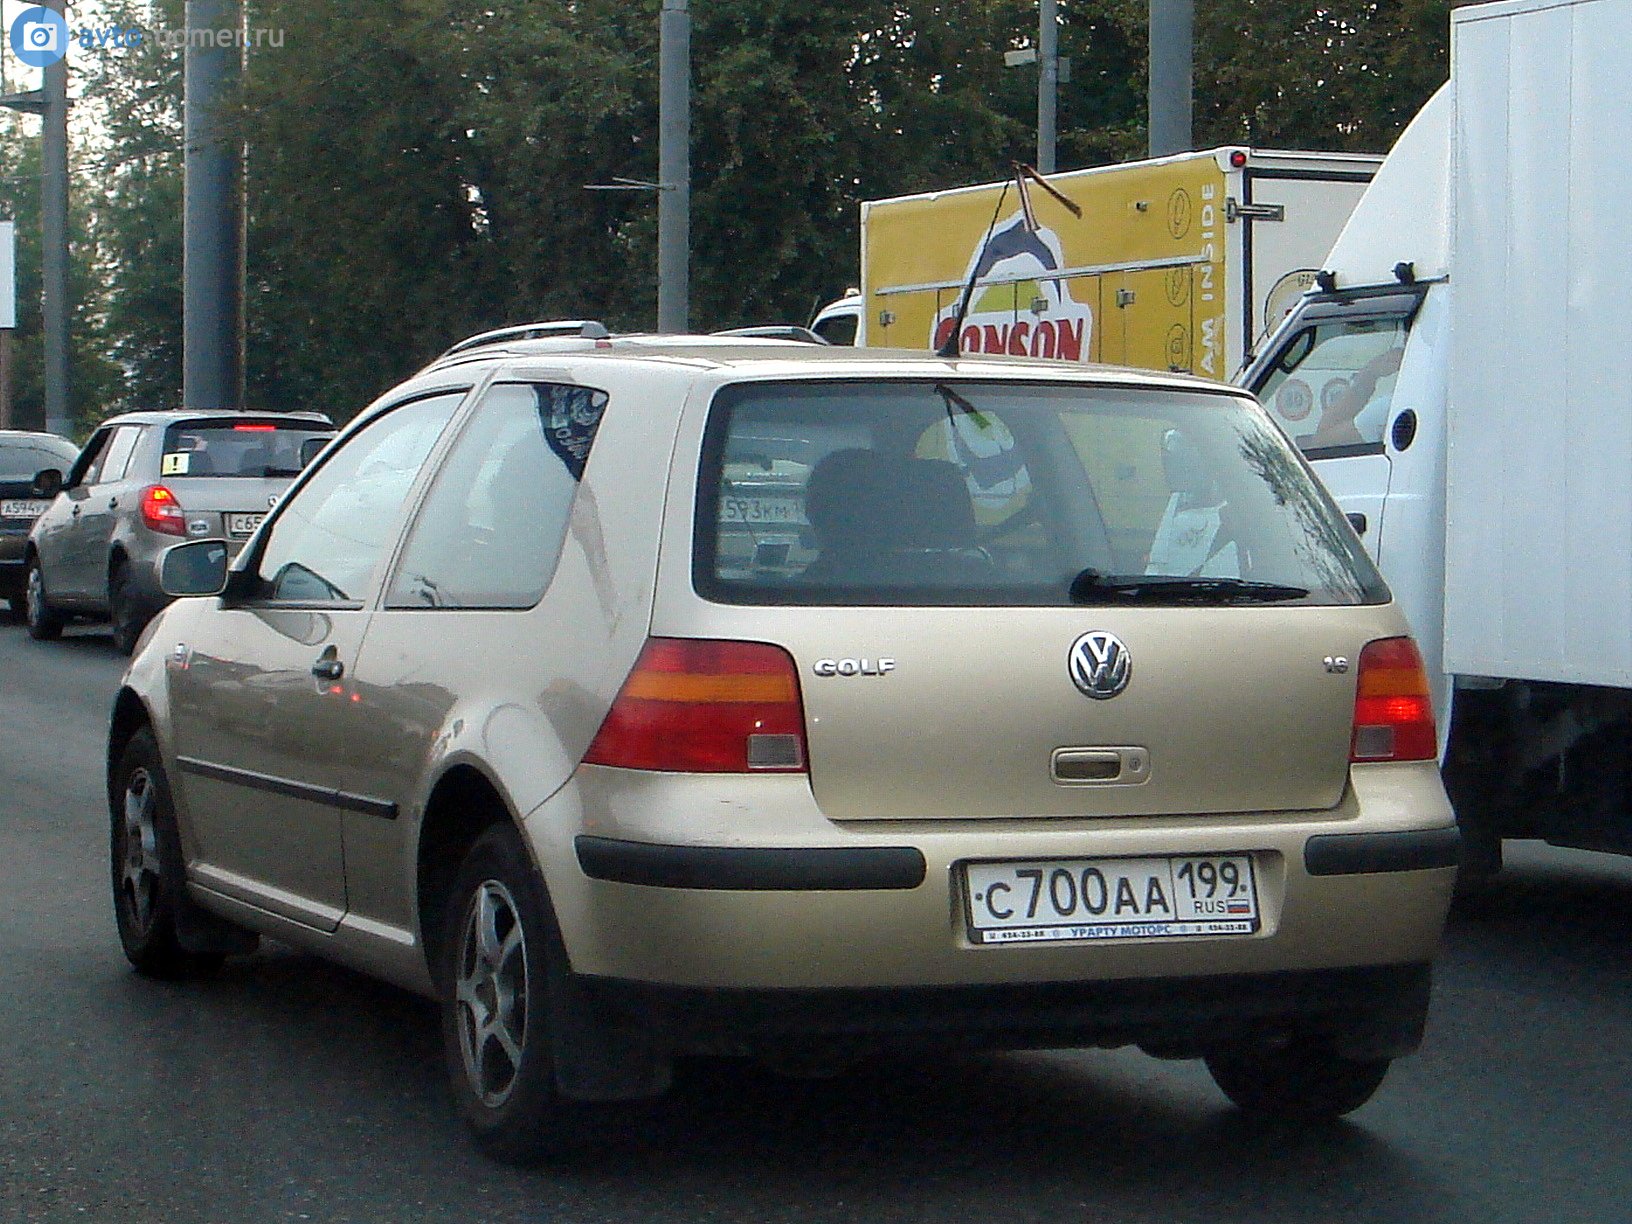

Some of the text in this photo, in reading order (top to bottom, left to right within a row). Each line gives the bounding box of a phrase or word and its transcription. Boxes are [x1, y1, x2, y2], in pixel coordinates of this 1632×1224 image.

[813, 657, 895, 677] GOLF
[1177, 861, 1240, 899] 199
[1194, 899, 1226, 914] RUS
[1071, 926, 1118, 938] УРАРТУ
[1120, 924, 1172, 936] МОТОРС
